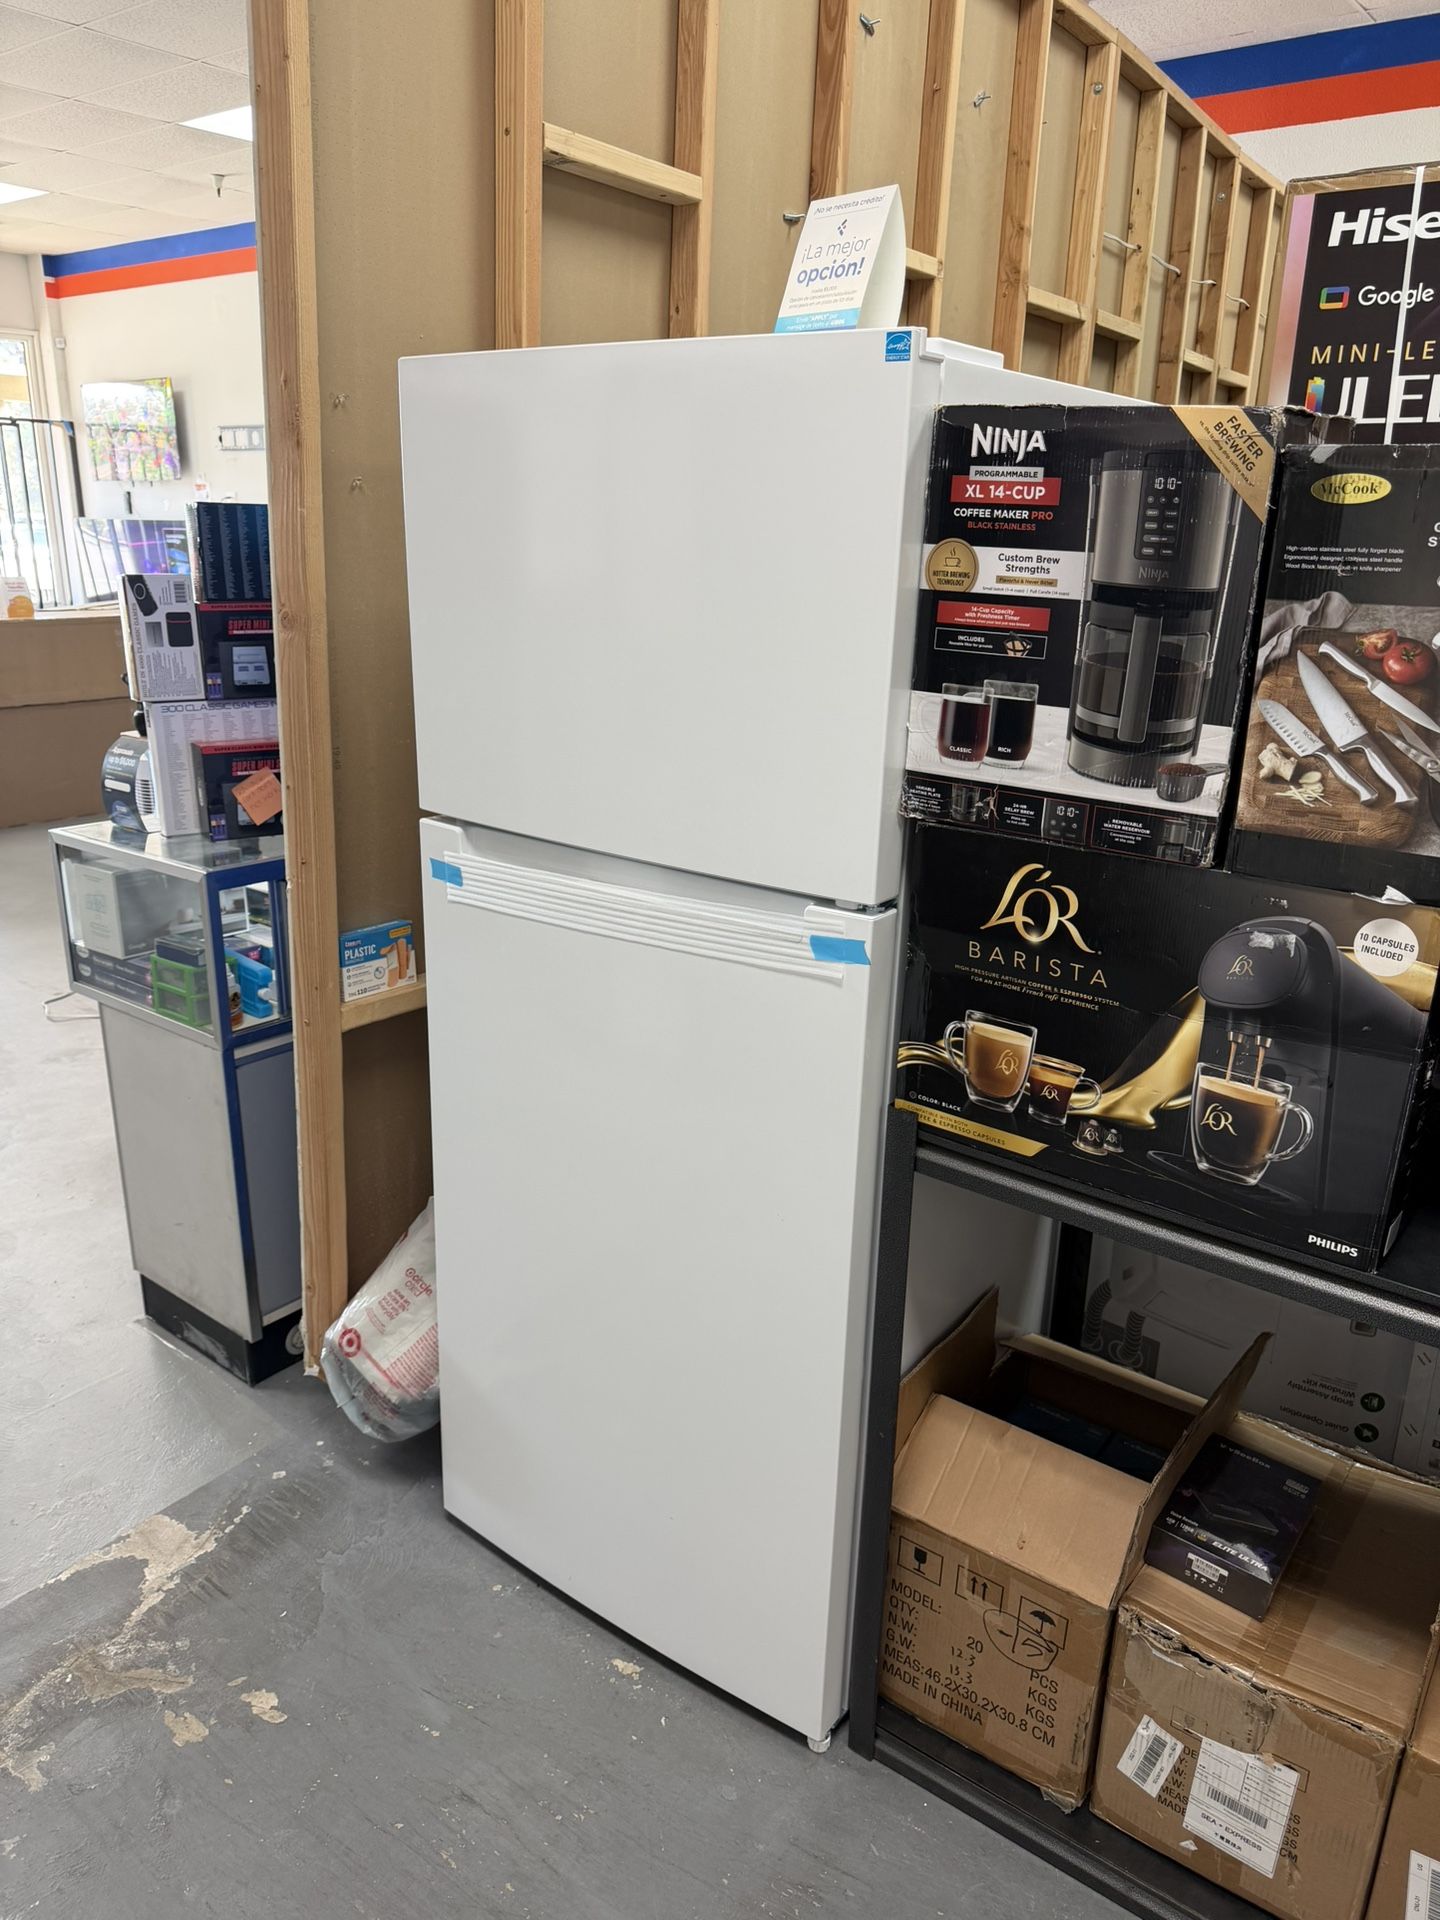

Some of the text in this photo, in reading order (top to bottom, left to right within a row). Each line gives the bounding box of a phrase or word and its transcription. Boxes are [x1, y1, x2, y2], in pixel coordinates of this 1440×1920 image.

[801, 236, 871, 264] ¡La mejor
[796, 256, 866, 288] opción!
[1357, 282, 1435, 310] Google
[1310, 340, 1437, 366] MINI-LE
[970, 422, 1047, 464] NINJA
[1213, 421, 1256, 472] BREWING
[1226, 415, 1263, 460] FASTER
[974, 470, 1039, 479] PROGRAMMABLE
[965, 484, 1046, 500] XL 14-CUP
[1320, 482, 1379, 496] McCook
[953, 507, 1054, 521] COFFEE MAKER PRO
[967, 521, 1036, 532] BLACK STAINLESS
[998, 553, 1061, 565] Custom Brew
[1283, 553, 1319, 561] Ergonomically
[1369, 547, 1387, 555] forged
[949, 571, 971, 579] BREWING
[1005, 564, 1051, 576] Strengths
[1138, 566, 1170, 583] NINJA
[1373, 565, 1402, 574] sharpener
[936, 578, 965, 587] TECHNOLOGY
[971, 606, 1015, 616] 14-Cup Capacity
[977, 612, 1003, 620] Freshness
[228, 619, 270, 630] SUPER MINI
[958, 635, 985, 643] INCLUDES
[160, 701, 269, 714] 300 CLASSIC GAMES
[949, 745, 972, 754] CLASSIC
[997, 745, 1012, 753] RICH
[231, 760, 256, 772] SUPER
[1103, 822, 1151, 834] WATER RESERVOIR
[1112, 818, 1143, 828] REMOVABLE
[344, 944, 377, 960] PLASTIC
[1358, 931, 1416, 954] 10 CAPSULES
[1360, 944, 1404, 963] INCLUDED
[968, 940, 1108, 989] BARISTA
[971, 975, 983, 983] FOR
[1021, 986, 1044, 998] French
[1044, 992, 1060, 1002] café
[1060, 996, 1100, 1012] EXPERIENCE
[1001, 974, 1027, 986] ARTISAN
[1027, 980, 1053, 992] COFFEE
[1059, 988, 1093, 1001] ESPRESSO
[1094, 996, 1120, 1007] SYSTEM
[917, 1094, 961, 1112] COLOR: BLACK
[907, 1104, 969, 1128] COMPATIBLE WITH BOTH
[938, 1119, 972, 1135] ESPRESSO
[972, 1130, 1006, 1146] CAPSULES
[1307, 1233, 1359, 1258] PHILIPS
[1287, 1380, 1330, 1399] Assembly
[1319, 1383, 1356, 1399] Window
[1279, 1405, 1349, 1433] Quiet Operation
[1212, 1541, 1239, 1556] ELITE
[1238, 1553, 1269, 1572] ULTRA
[891, 1578, 943, 1615] MODEL:
[887, 1611, 918, 1637] N.W:
[886, 1627, 916, 1653] G.W:
[888, 1595, 1059, 1694] QTY: 20 PCS
[950, 1646, 976, 1667] 12.3
[882, 1659, 984, 1727] MADE IN CHINA
[884, 1643, 1057, 1748] MEAS:46.2X30.2X30.8 CM
[1027, 1686, 1058, 1712] KGS
[1025, 1703, 1056, 1729] KGS
[1157, 1794, 1188, 1817] MADE
[1201, 1811, 1217, 1826] SEA
[1224, 1826, 1262, 1852] EXPRESS
[1279, 1847, 1299, 1864] CM
